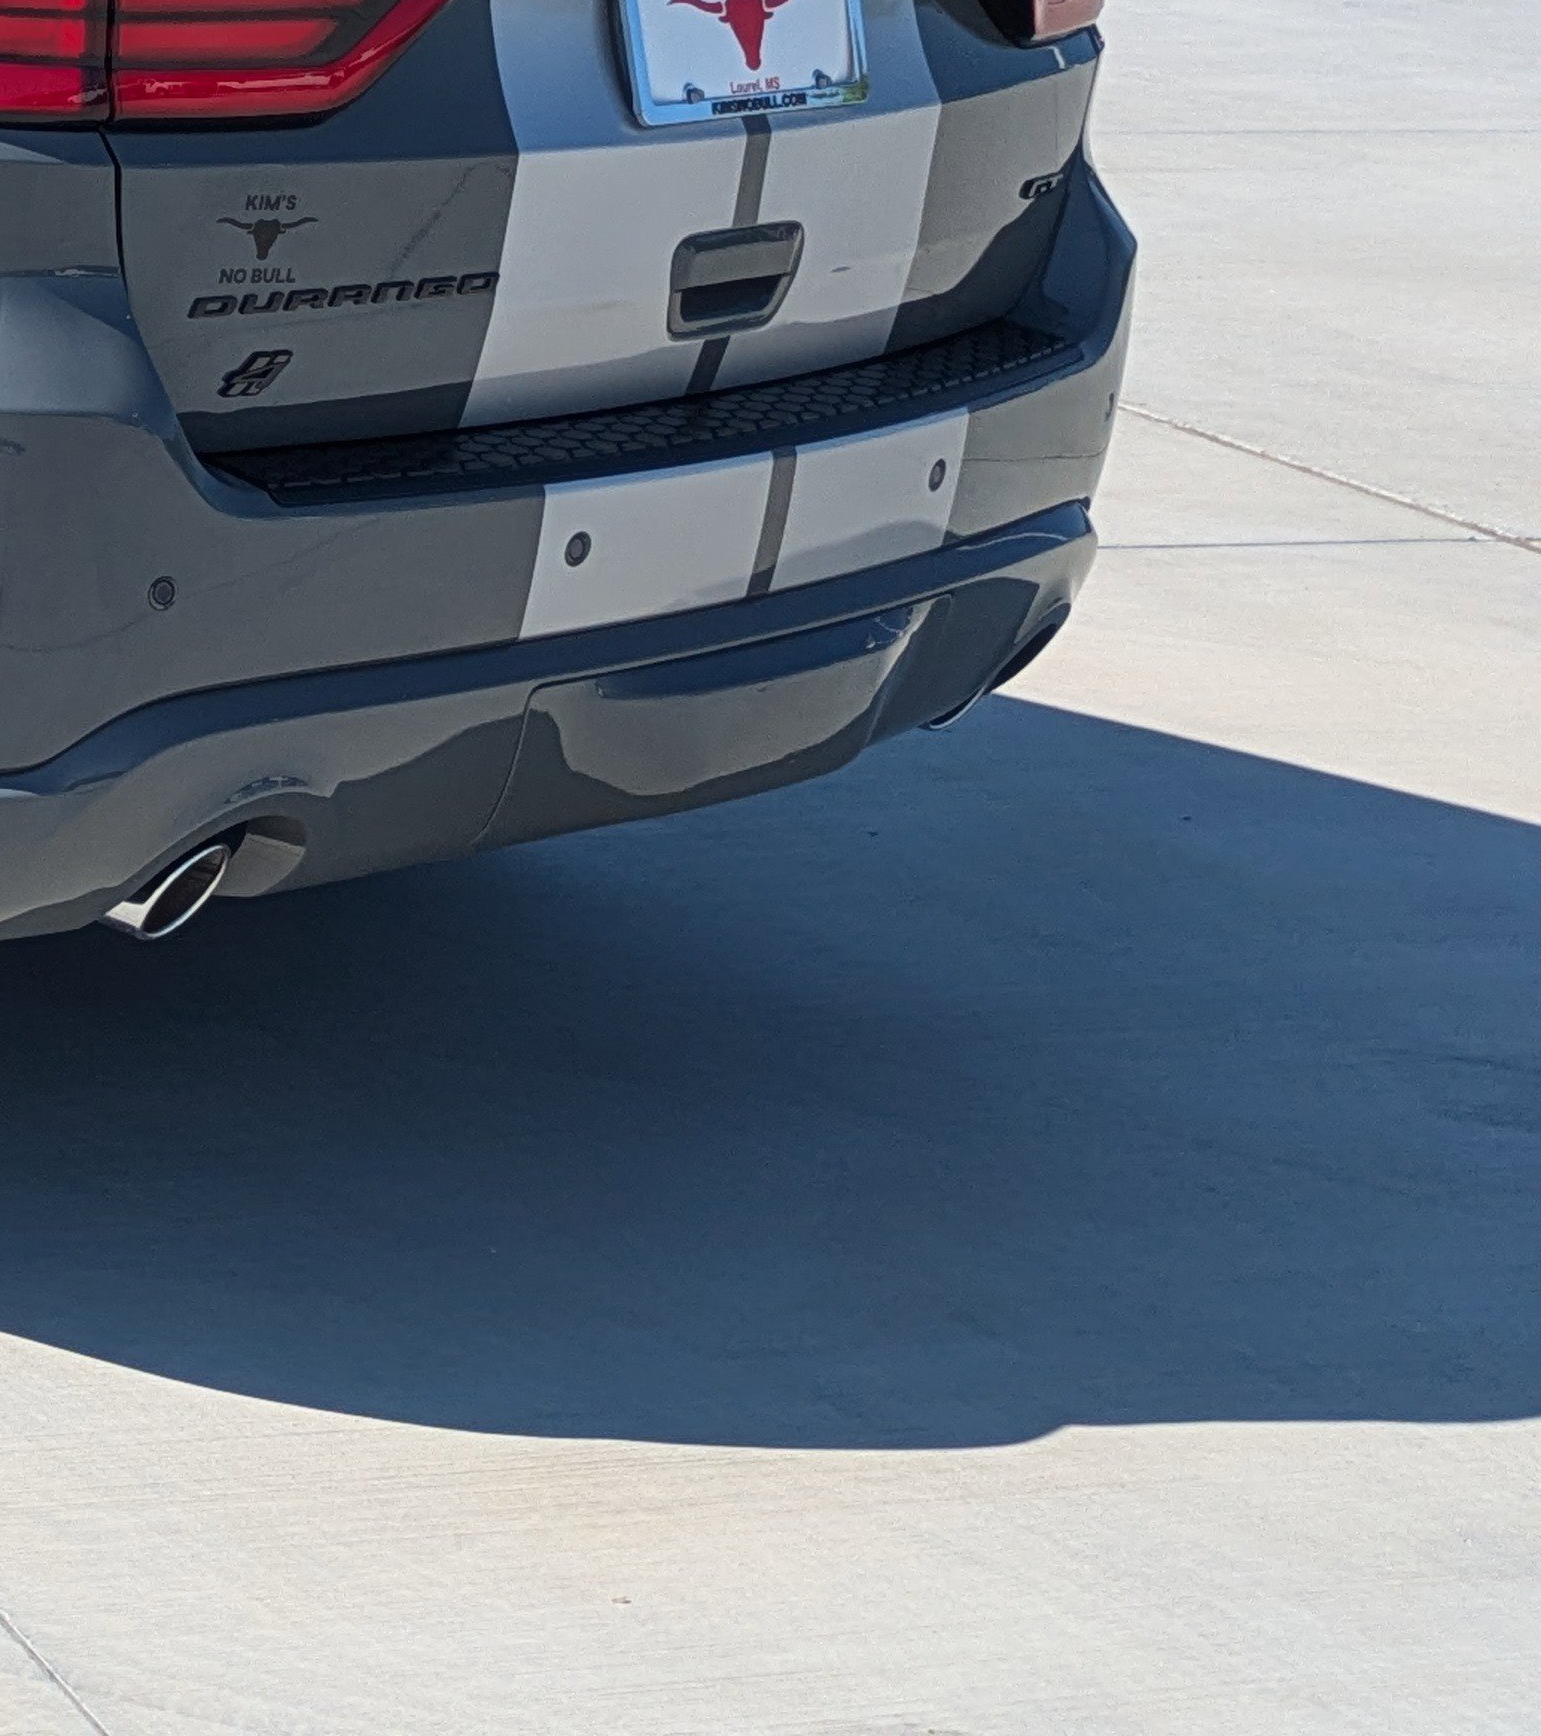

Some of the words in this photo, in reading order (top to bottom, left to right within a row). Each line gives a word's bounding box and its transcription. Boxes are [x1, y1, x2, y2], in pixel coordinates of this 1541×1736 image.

[729, 80, 765, 95] Laurel,
[245, 194, 297, 211] KIM'S
[218, 268, 247, 284] NO
[250, 268, 296, 284] BULL
[186, 271, 500, 319] DURANGO
